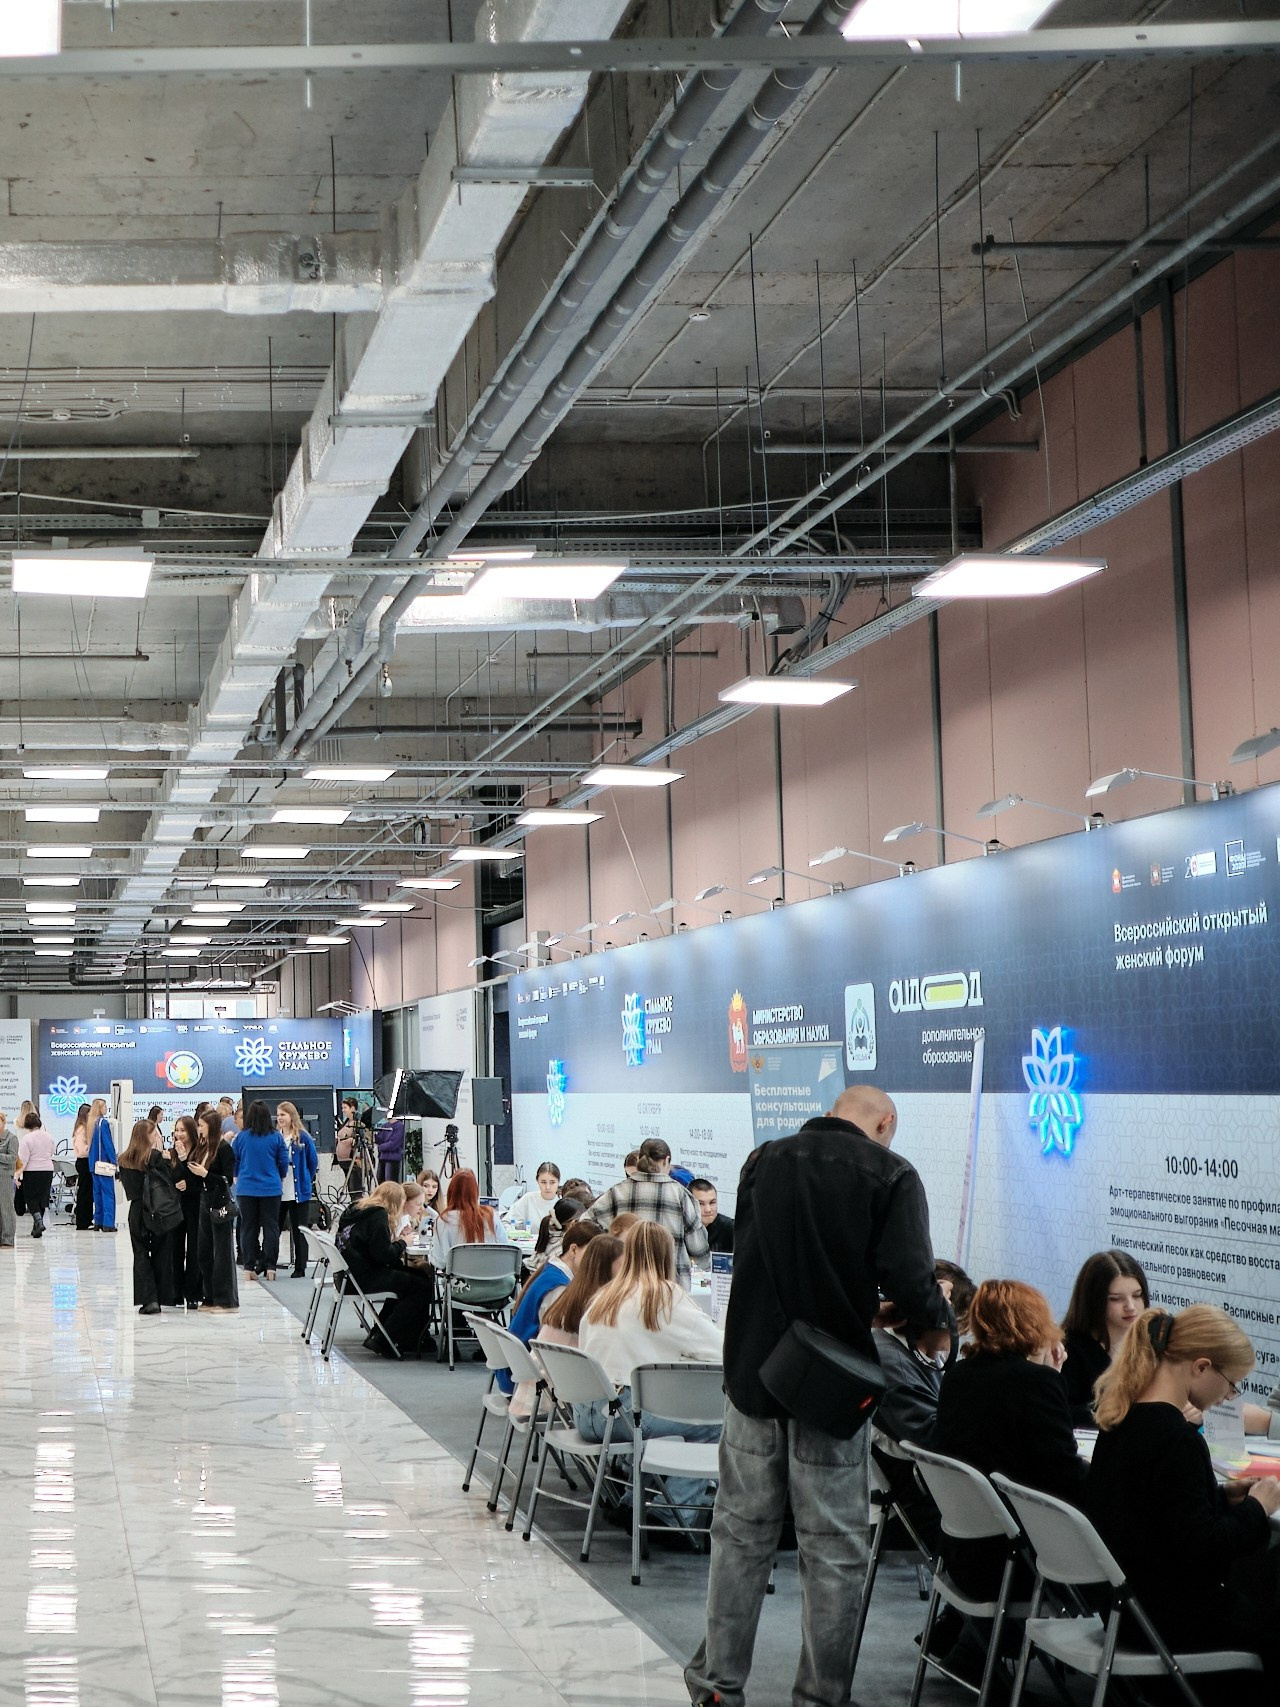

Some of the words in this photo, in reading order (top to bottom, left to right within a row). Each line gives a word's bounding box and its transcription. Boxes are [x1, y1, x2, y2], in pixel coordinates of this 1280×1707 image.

[1114, 913, 1200, 943] Всероссийский
[1203, 902, 1267, 932] открытый
[1115, 946, 1163, 970] женский
[1165, 945, 1205, 968] форум
[752, 1005, 804, 1025] МИНИСТЕРСТВО
[806, 1025, 830, 1042] НАУКИ
[922, 1027, 985, 1045] дополнительное
[278, 1041, 333, 1050] СТАЛЬНОЕ
[278, 1051, 329, 1060] КРУЖЕВО
[922, 1048, 973, 1067] образование
[278, 1061, 310, 1070] УРАЛА
[754, 1084, 811, 1097] Бесплатные
[755, 1101, 821, 1115] консультации
[757, 1117, 775, 1128] для
[1165, 1155, 1239, 1179] 10:00-14:00
[1109, 1185, 1191, 1205] Арт-терапевтическое
[1192, 1194, 1227, 1208] занятие
[1228, 1199, 1239, 1210] по
[1110, 1206, 1173, 1223] эмоционального
[1174, 1213, 1219, 1230] выгорания
[1111, 1234, 1164, 1253] Кинетический
[1165, 1245, 1189, 1257] песок
[1190, 1248, 1205, 1259] как
[1205, 1251, 1247, 1266] средство
[1177, 1267, 1227, 1284] равновесия
